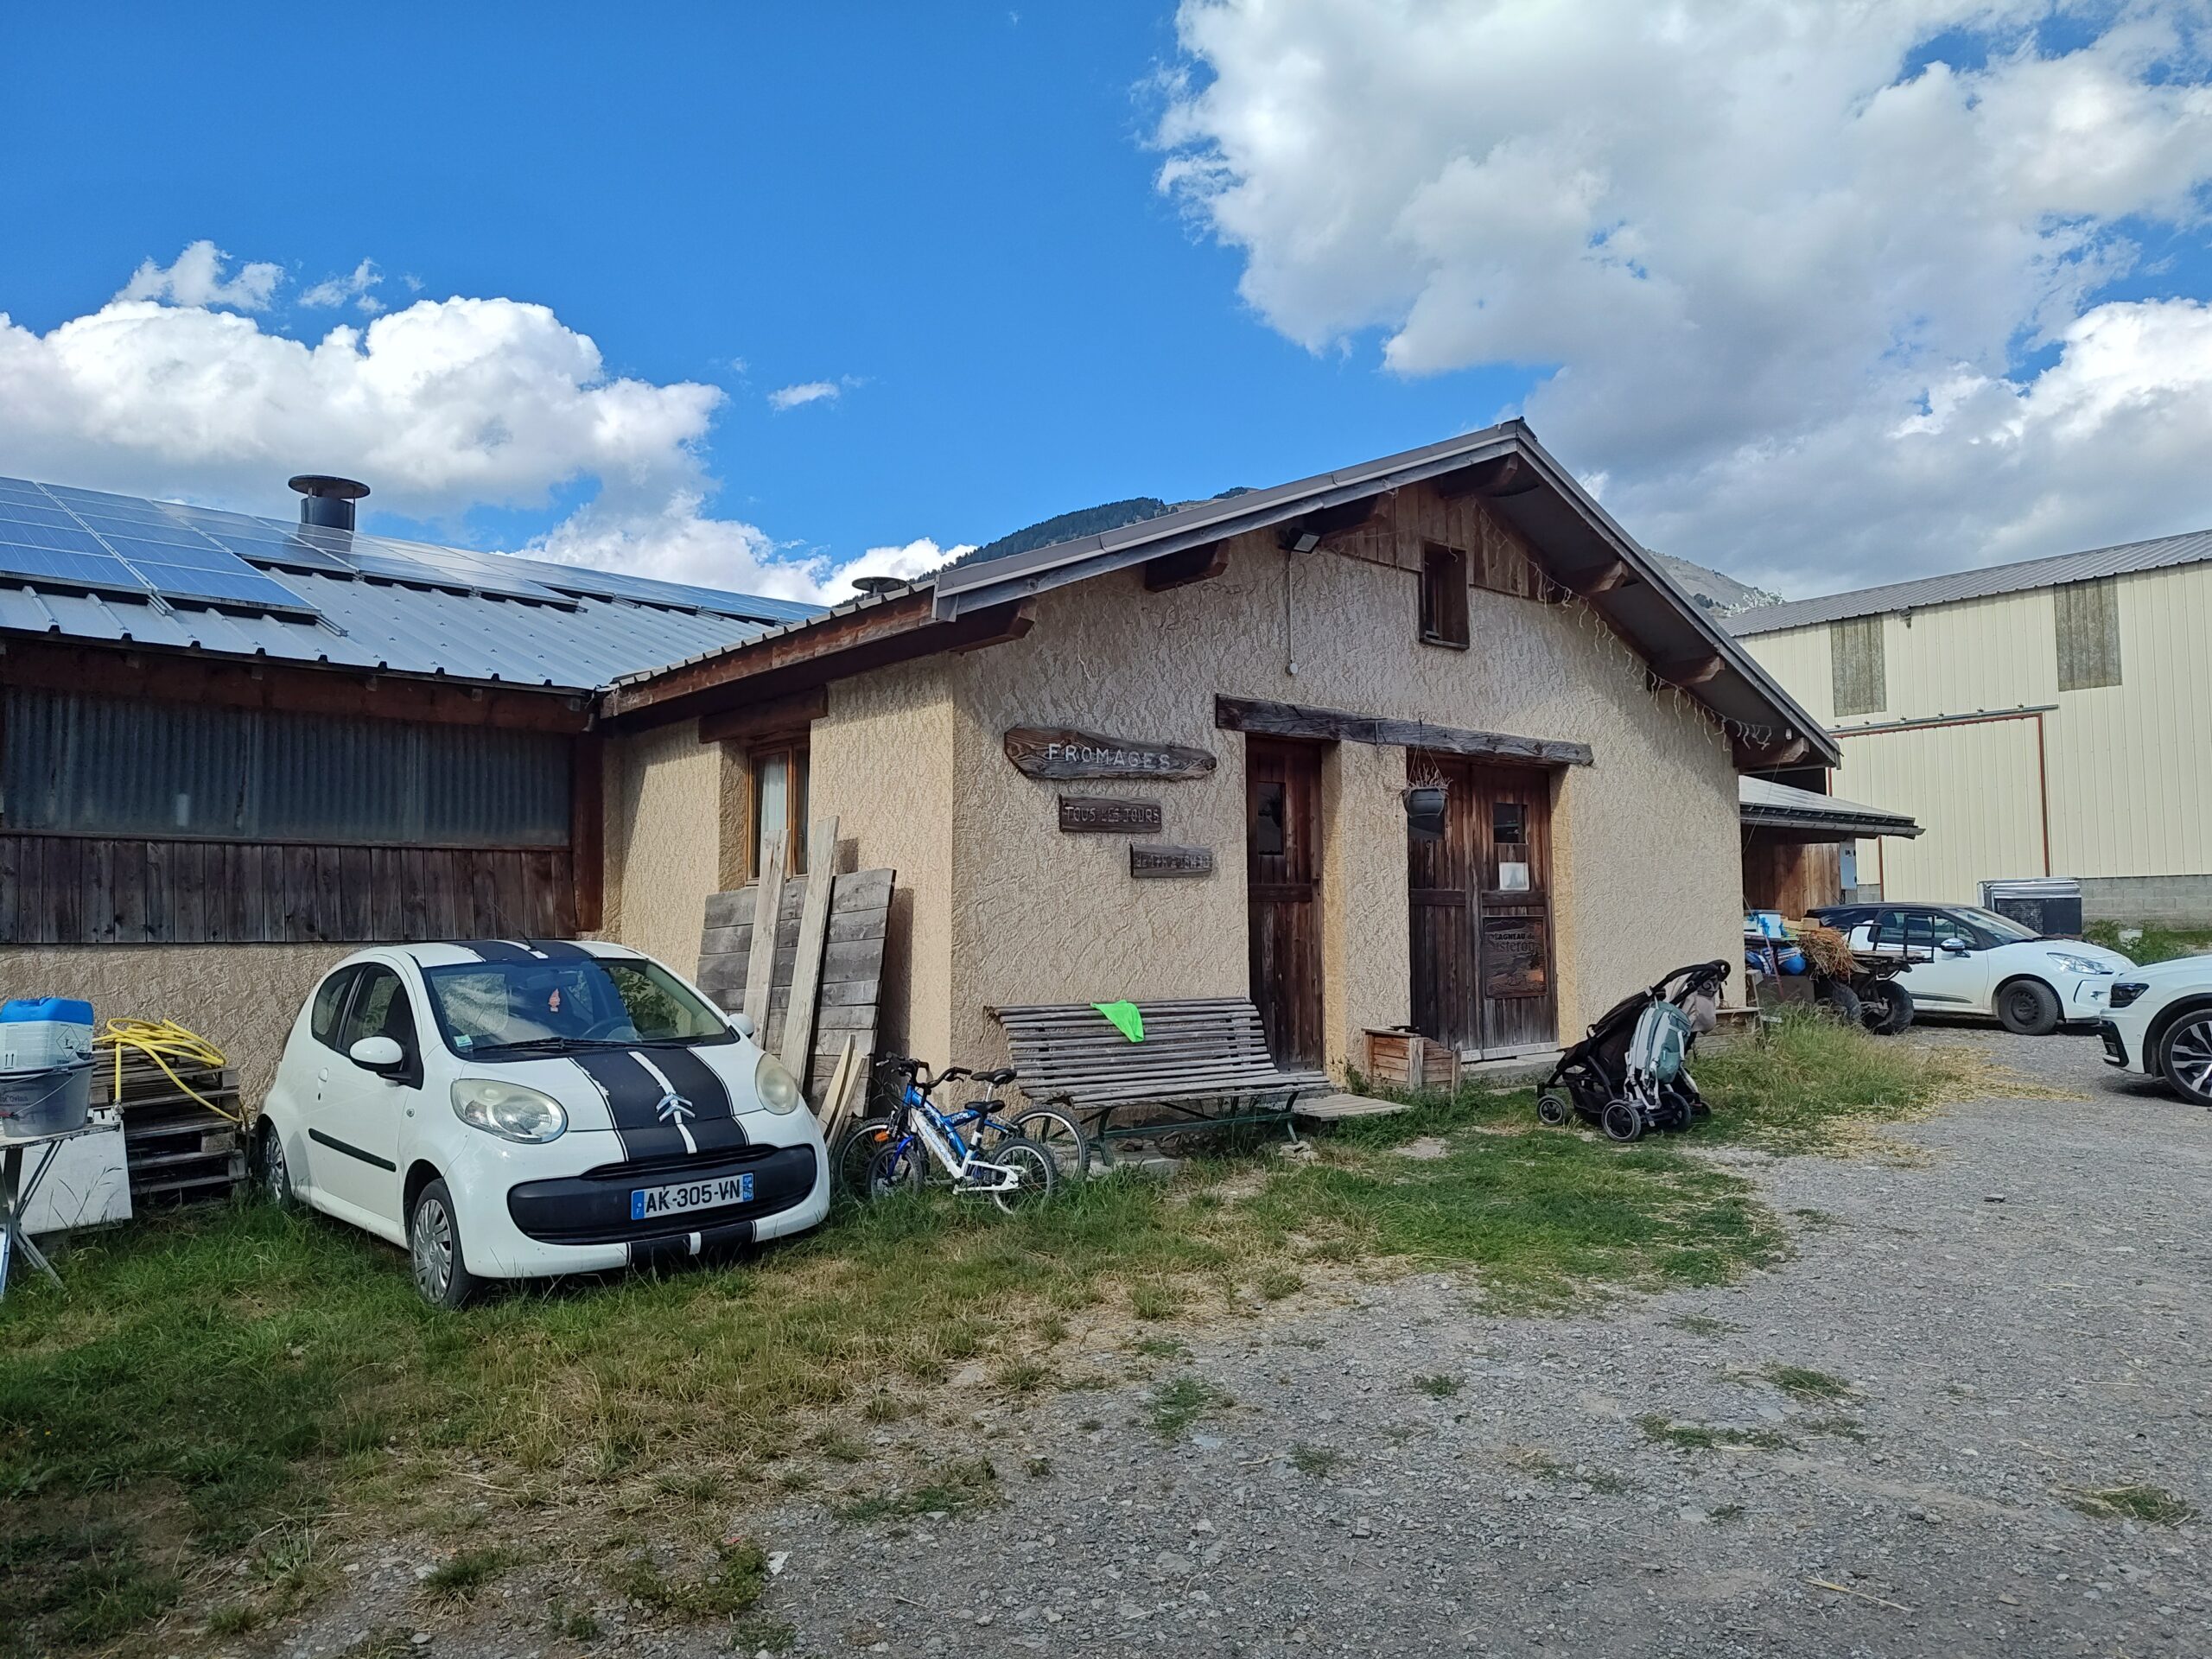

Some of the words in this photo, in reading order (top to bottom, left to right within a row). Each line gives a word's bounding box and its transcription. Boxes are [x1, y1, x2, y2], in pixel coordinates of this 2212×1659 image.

[1048, 742, 1171, 771] FROMAGES
[1065, 806, 1096, 822] TOUS
[1101, 807, 1120, 823] LES
[1123, 808, 1160, 823] JOURS
[645, 1179, 741, 1213] AK-305-VN
